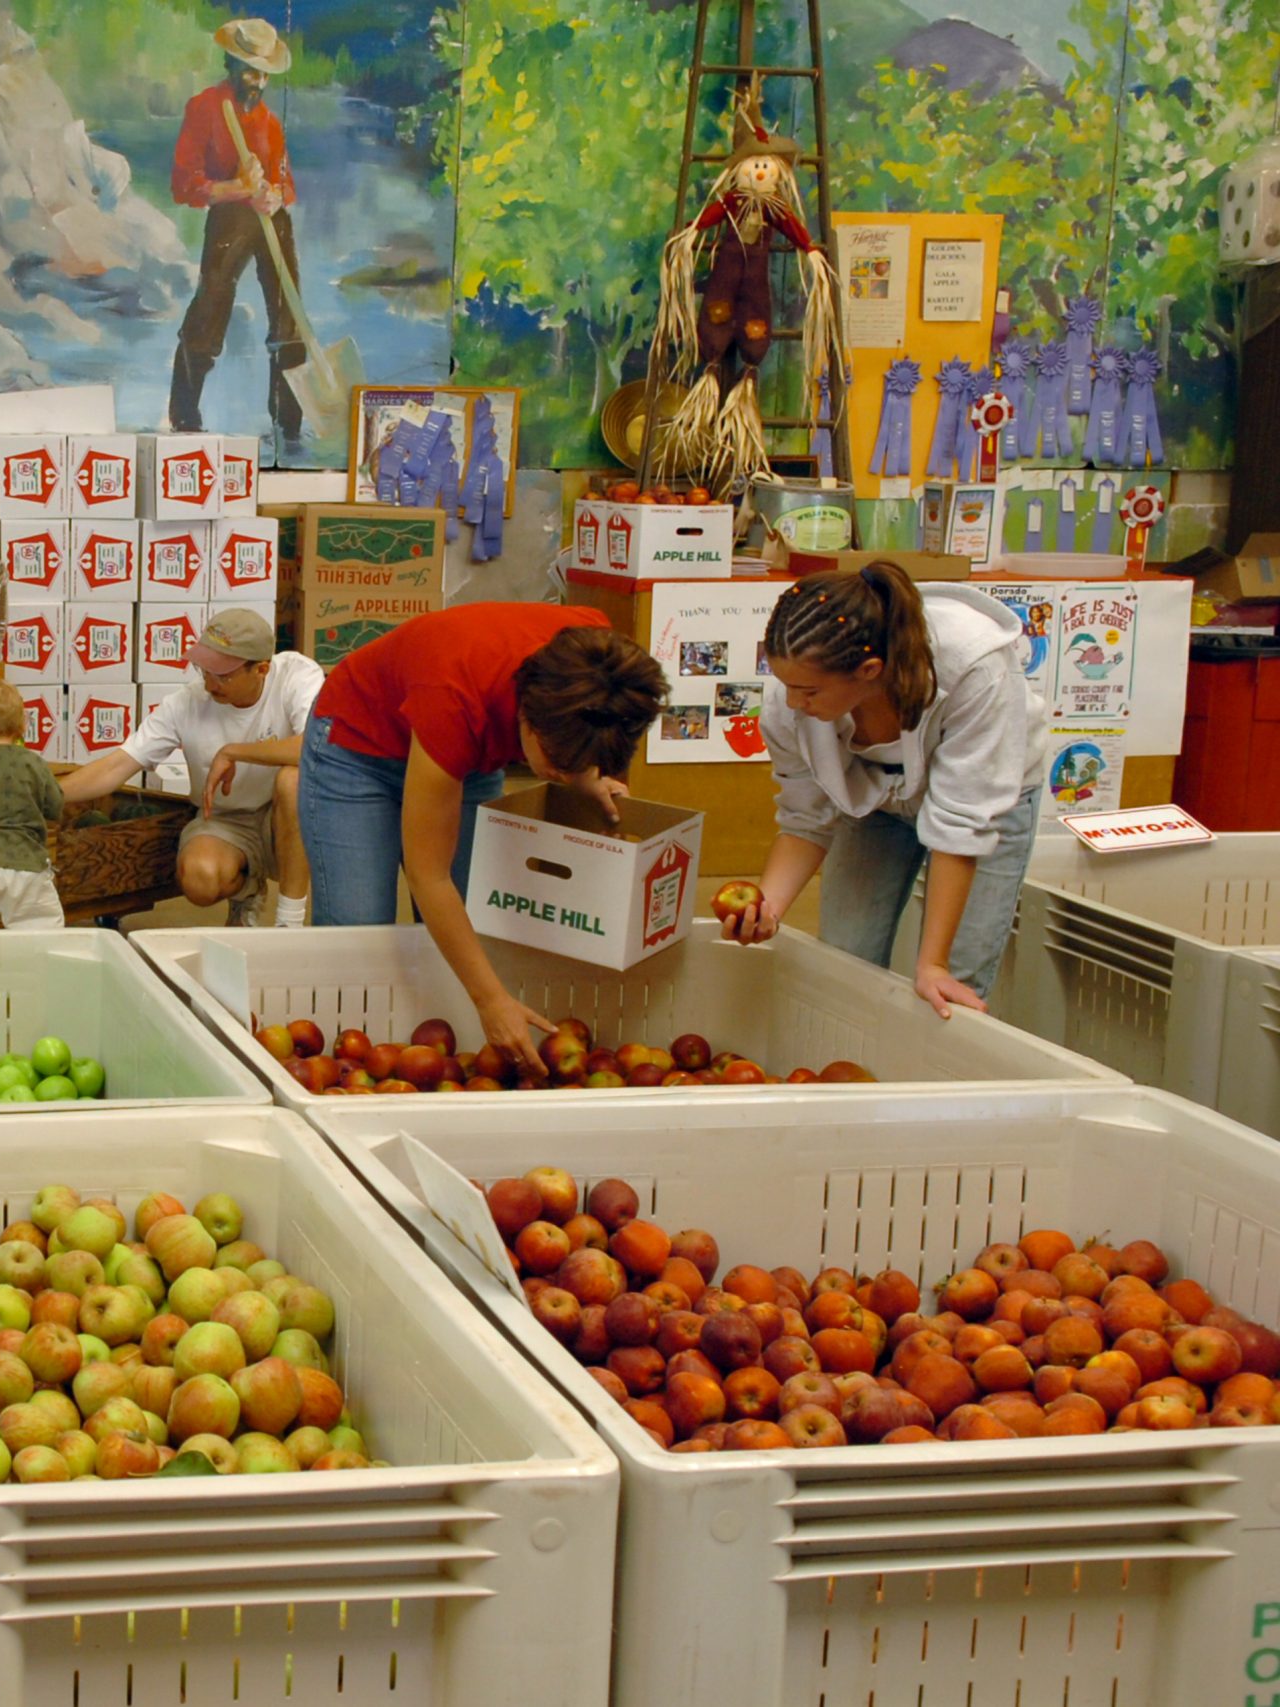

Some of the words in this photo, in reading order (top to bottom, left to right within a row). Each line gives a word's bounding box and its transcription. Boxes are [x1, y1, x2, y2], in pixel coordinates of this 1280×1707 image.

[653, 551, 694, 562] APPLE
[696, 551, 722, 562] HILL
[316, 569, 345, 584] HILL
[348, 570, 393, 585] APPLE
[991, 588, 1027, 596] Dorado
[996, 595, 1023, 604] ounty
[316, 600, 350, 618] From
[354, 600, 399, 613] APPLE
[402, 600, 431, 613] HILL
[679, 606, 712, 618] THANK
[721, 607, 742, 616] YOU
[1063, 601, 1087, 623] LIFE
[1093, 600, 1104, 612] IS
[1110, 601, 1135, 622] JUST
[1071, 617, 1087, 631] BOWL
[1088, 613, 1097, 625] OF
[1099, 613, 1128, 632] CHERRIES
[488, 815, 522, 832] CONTENTS
[563, 833, 595, 849] PRODUCE
[595, 841, 605, 850] OF
[487, 889, 556, 923] APPLE
[560, 907, 606, 937] HILL
